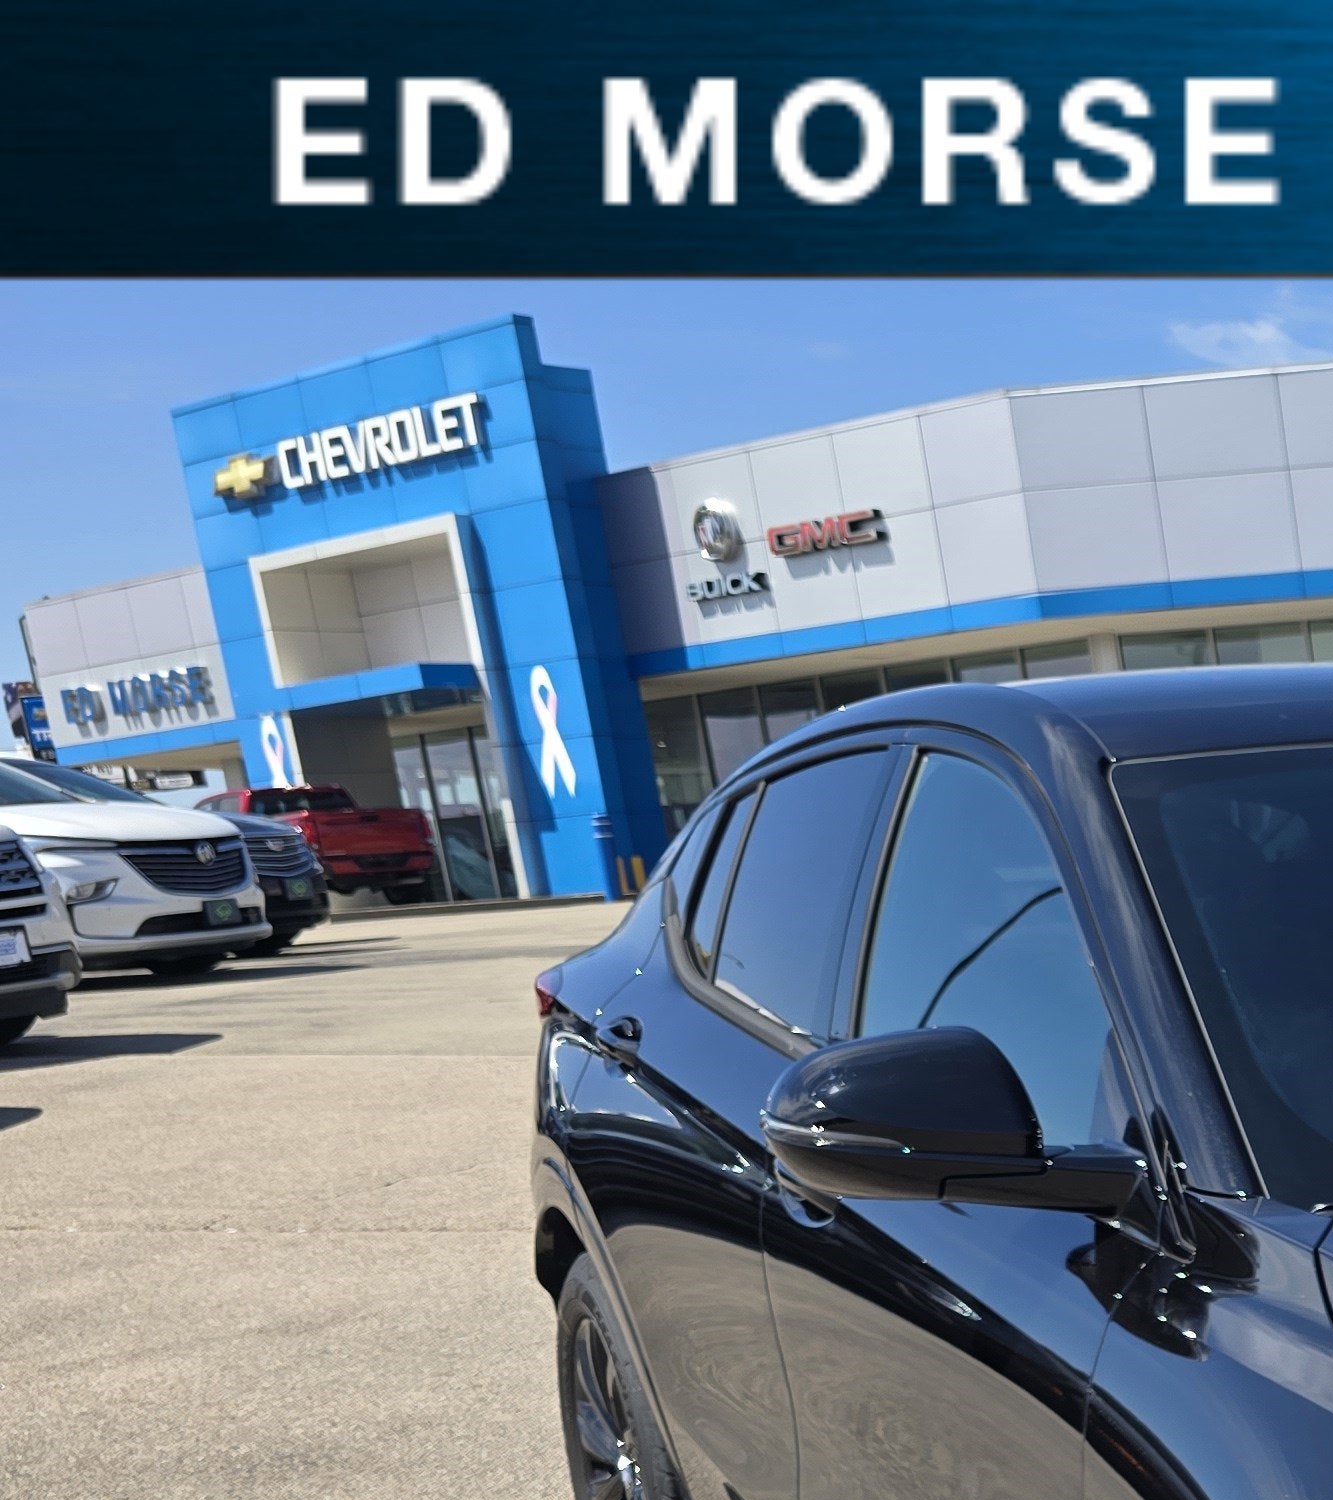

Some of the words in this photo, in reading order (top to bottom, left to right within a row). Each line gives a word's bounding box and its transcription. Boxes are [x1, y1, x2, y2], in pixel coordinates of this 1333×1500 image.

[277, 391, 479, 490] CHEVROLET
[767, 509, 878, 558] GMC
[687, 573, 763, 601] BUICK
